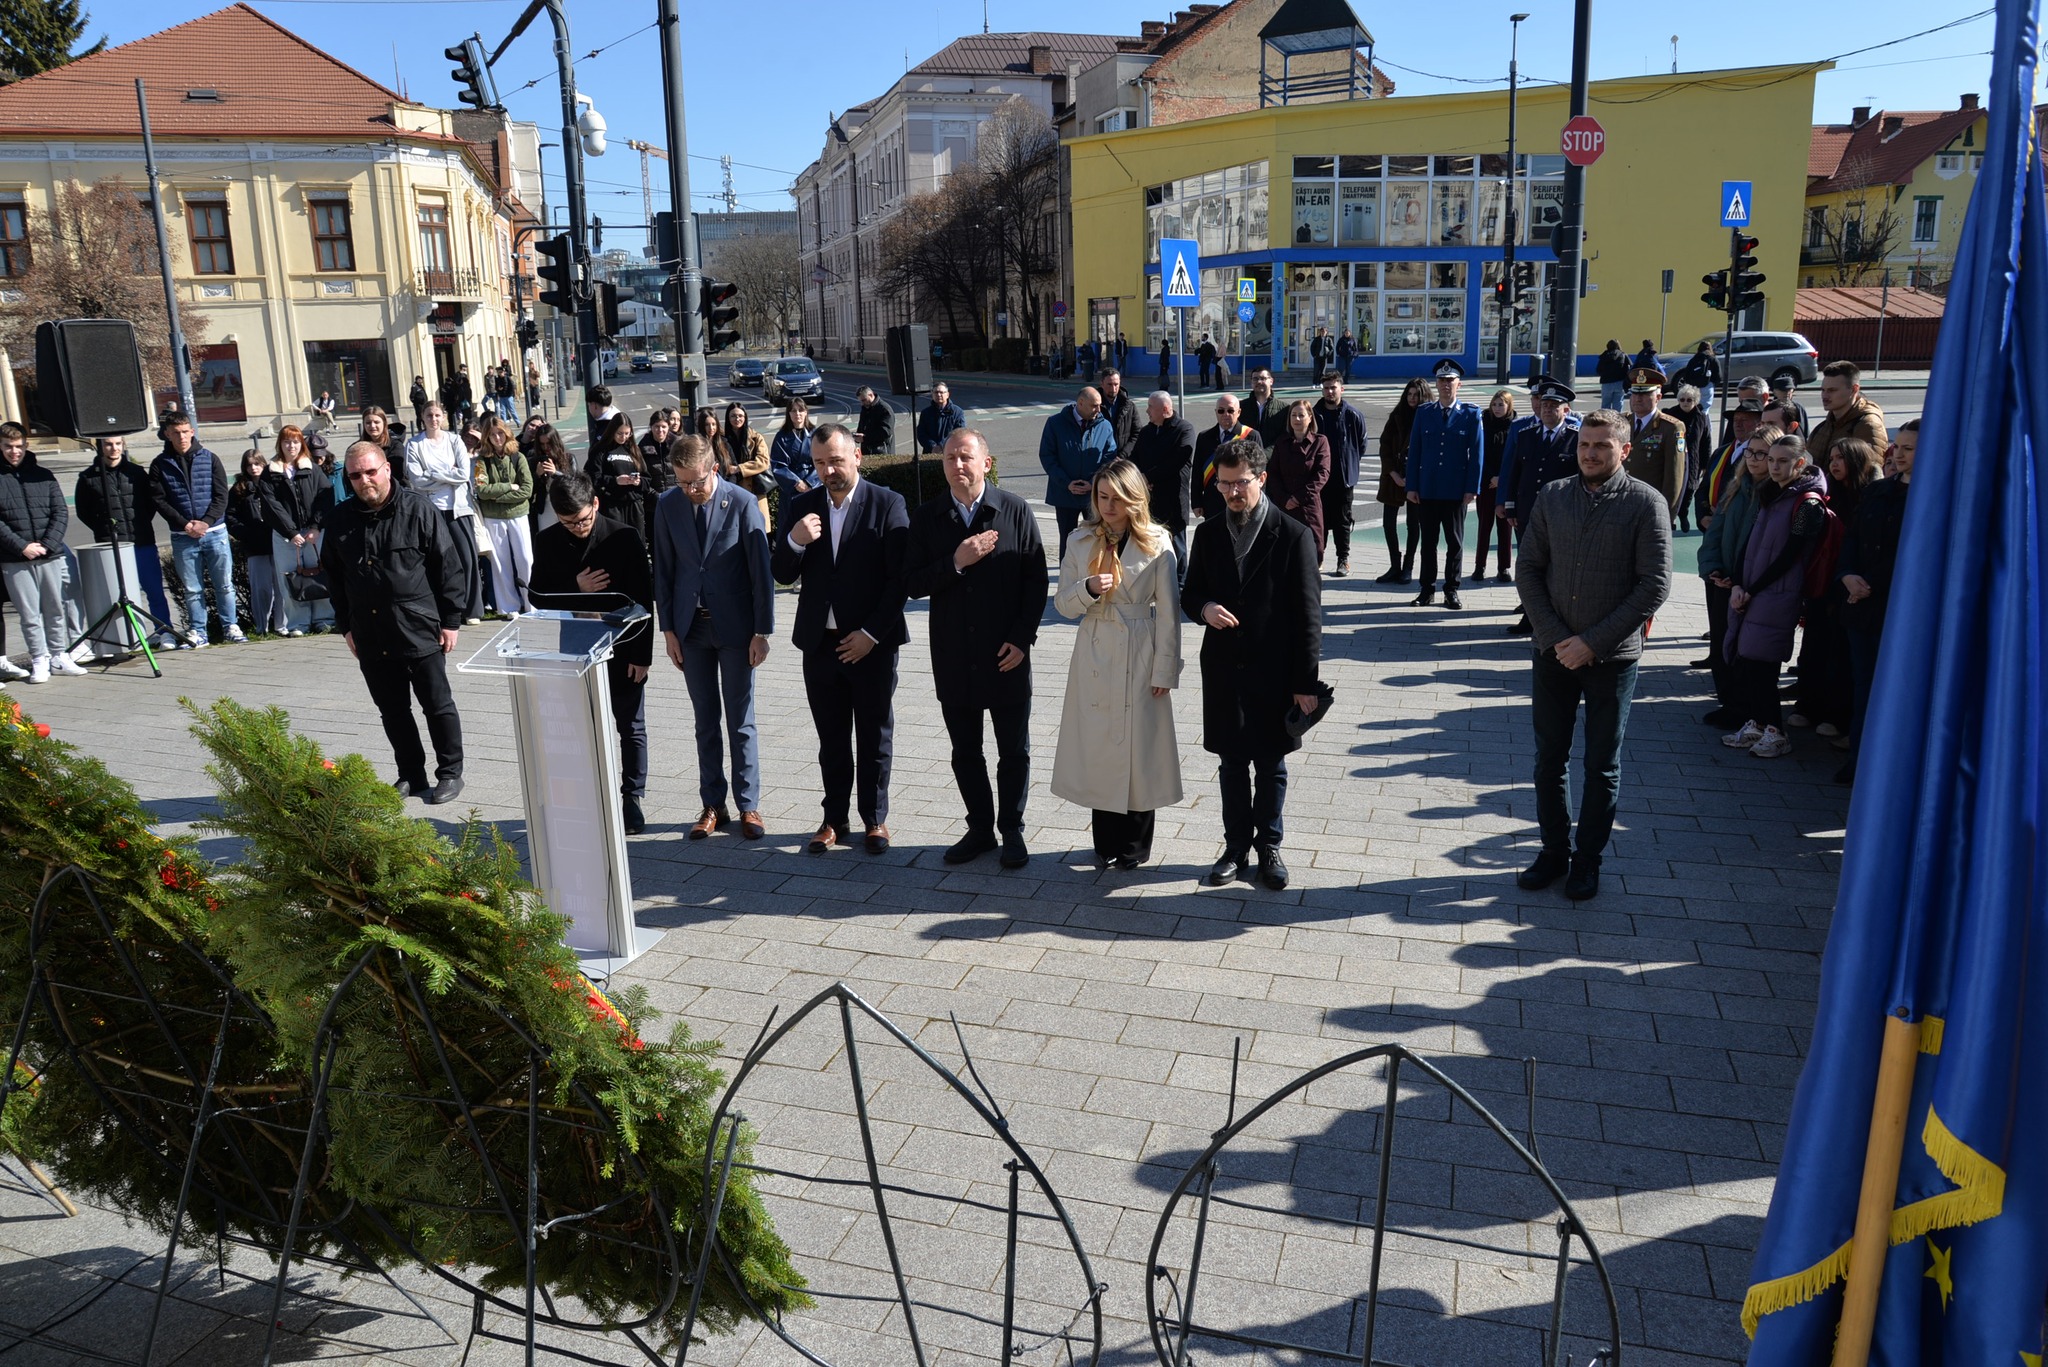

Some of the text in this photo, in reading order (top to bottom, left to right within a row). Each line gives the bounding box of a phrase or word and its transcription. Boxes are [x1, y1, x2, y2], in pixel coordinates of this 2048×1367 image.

[1563, 131, 1604, 152] STOP
[1393, 185, 1421, 193] PRODUSE
[1533, 185, 1564, 193] PERIFERI
[1295, 195, 1331, 206] IN-EAR
